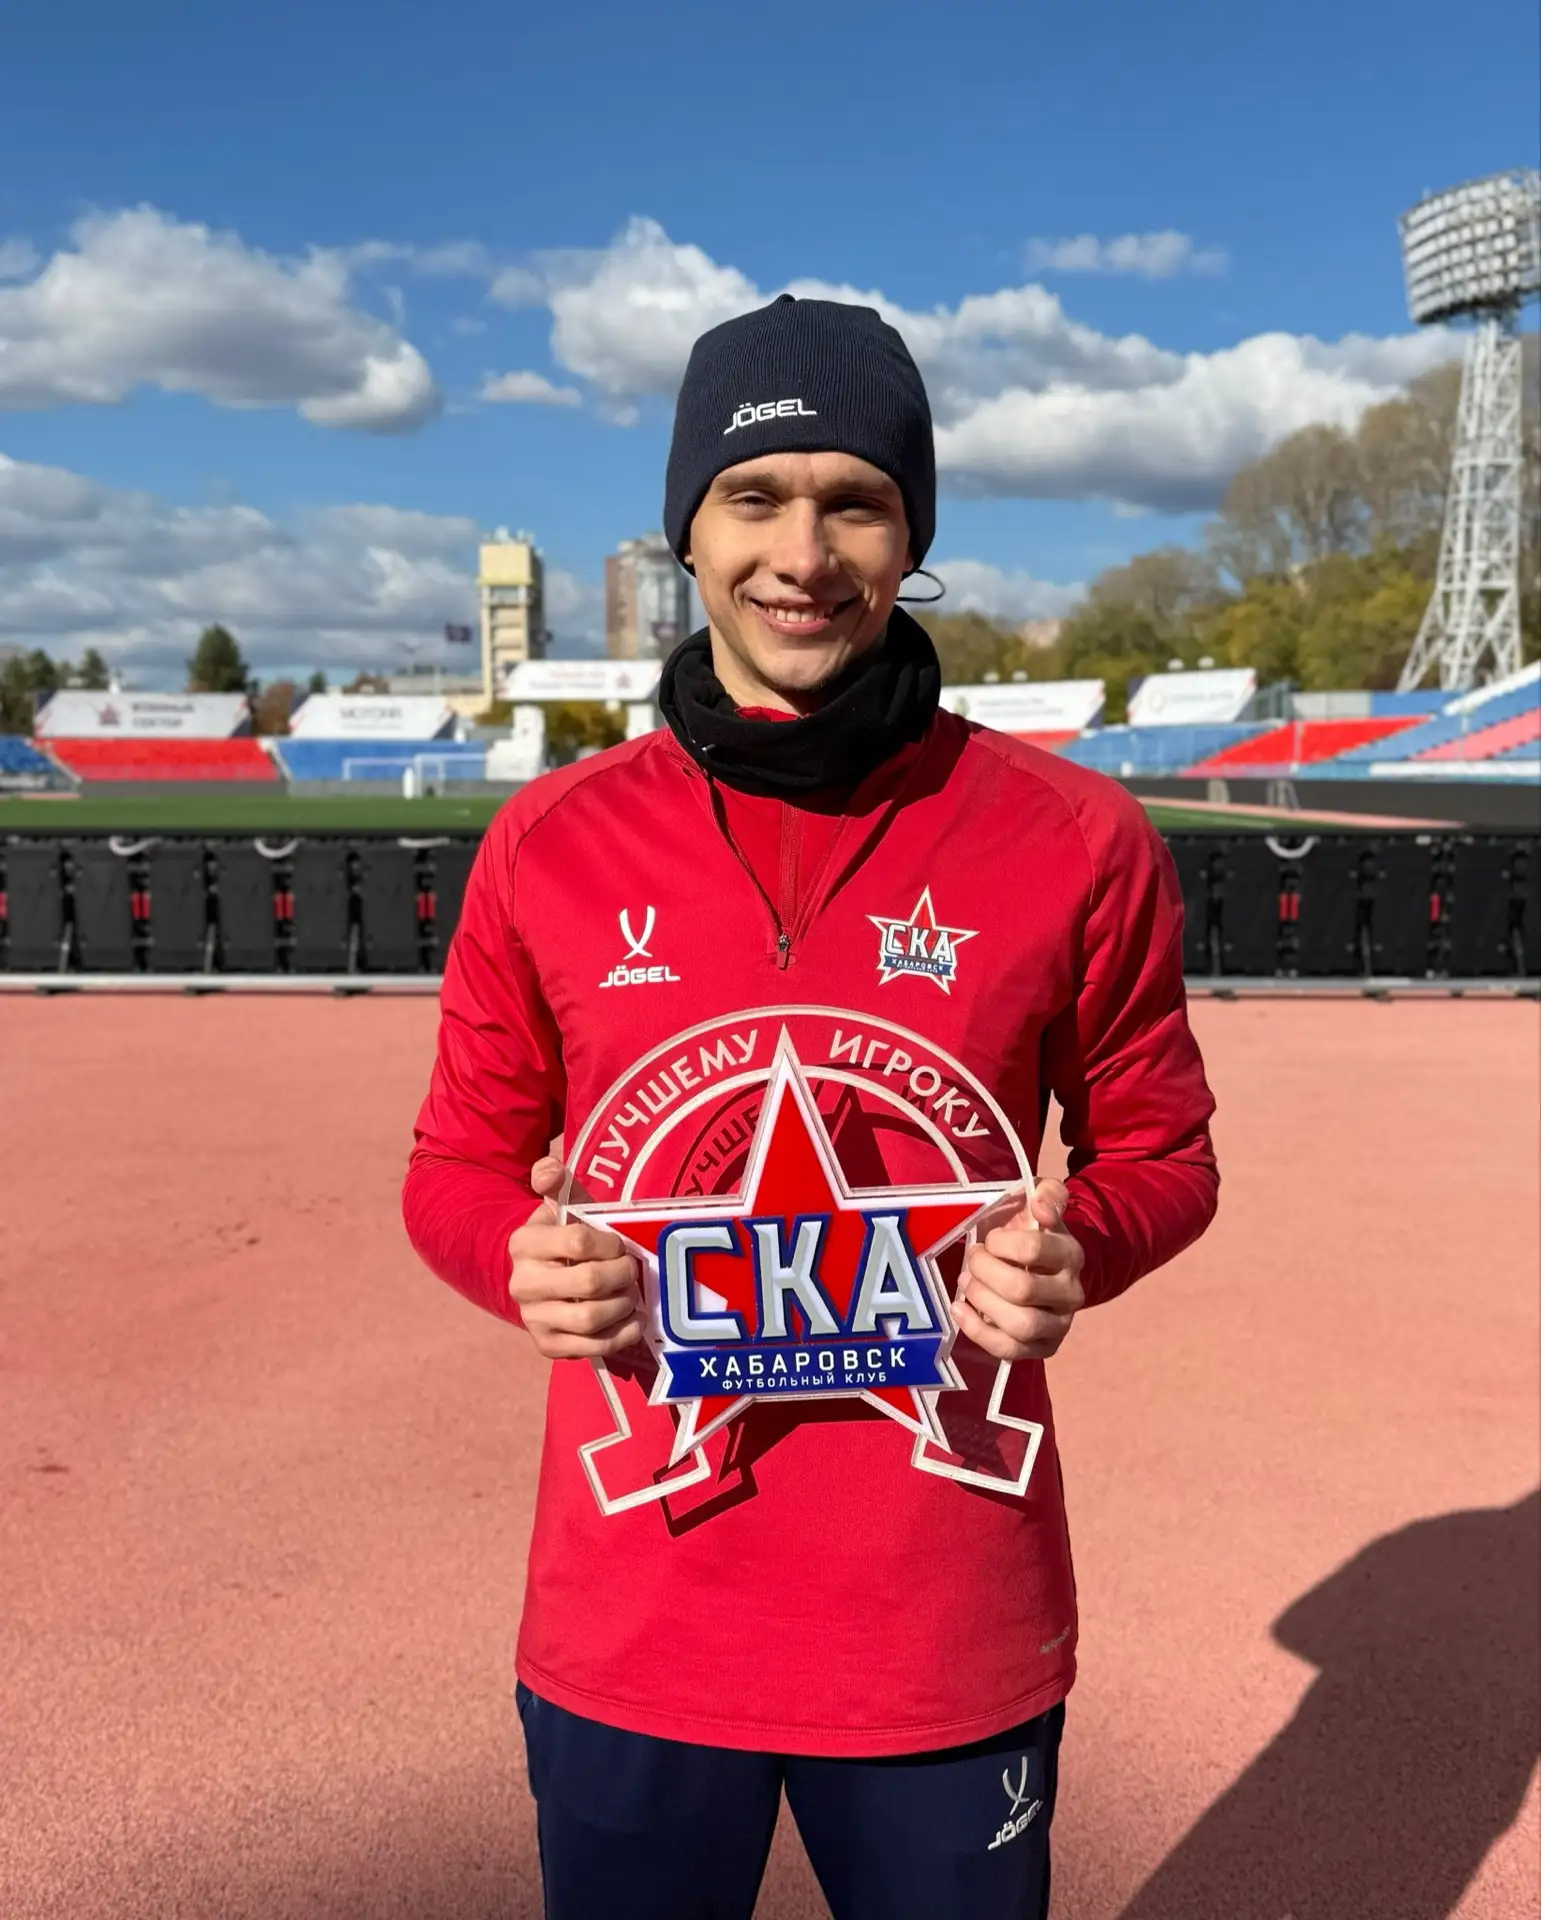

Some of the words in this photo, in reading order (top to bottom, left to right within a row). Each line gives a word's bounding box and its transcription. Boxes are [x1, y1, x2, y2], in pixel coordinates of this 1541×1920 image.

[723, 398, 817, 435] JÖGEL
[885, 923, 953, 963] СКА
[598, 964, 681, 988] JÖGEL
[586, 1028, 758, 1189] ЛУЧШЕМУ
[829, 1029, 991, 1139] ИГРОКУ
[662, 1213, 938, 1343] СКА
[698, 1346, 906, 1378] ХАБАРОВСК
[721, 1371, 835, 1391] ФУТБОЛЬНЫЙ
[844, 1371, 887, 1384] КЛУБ
